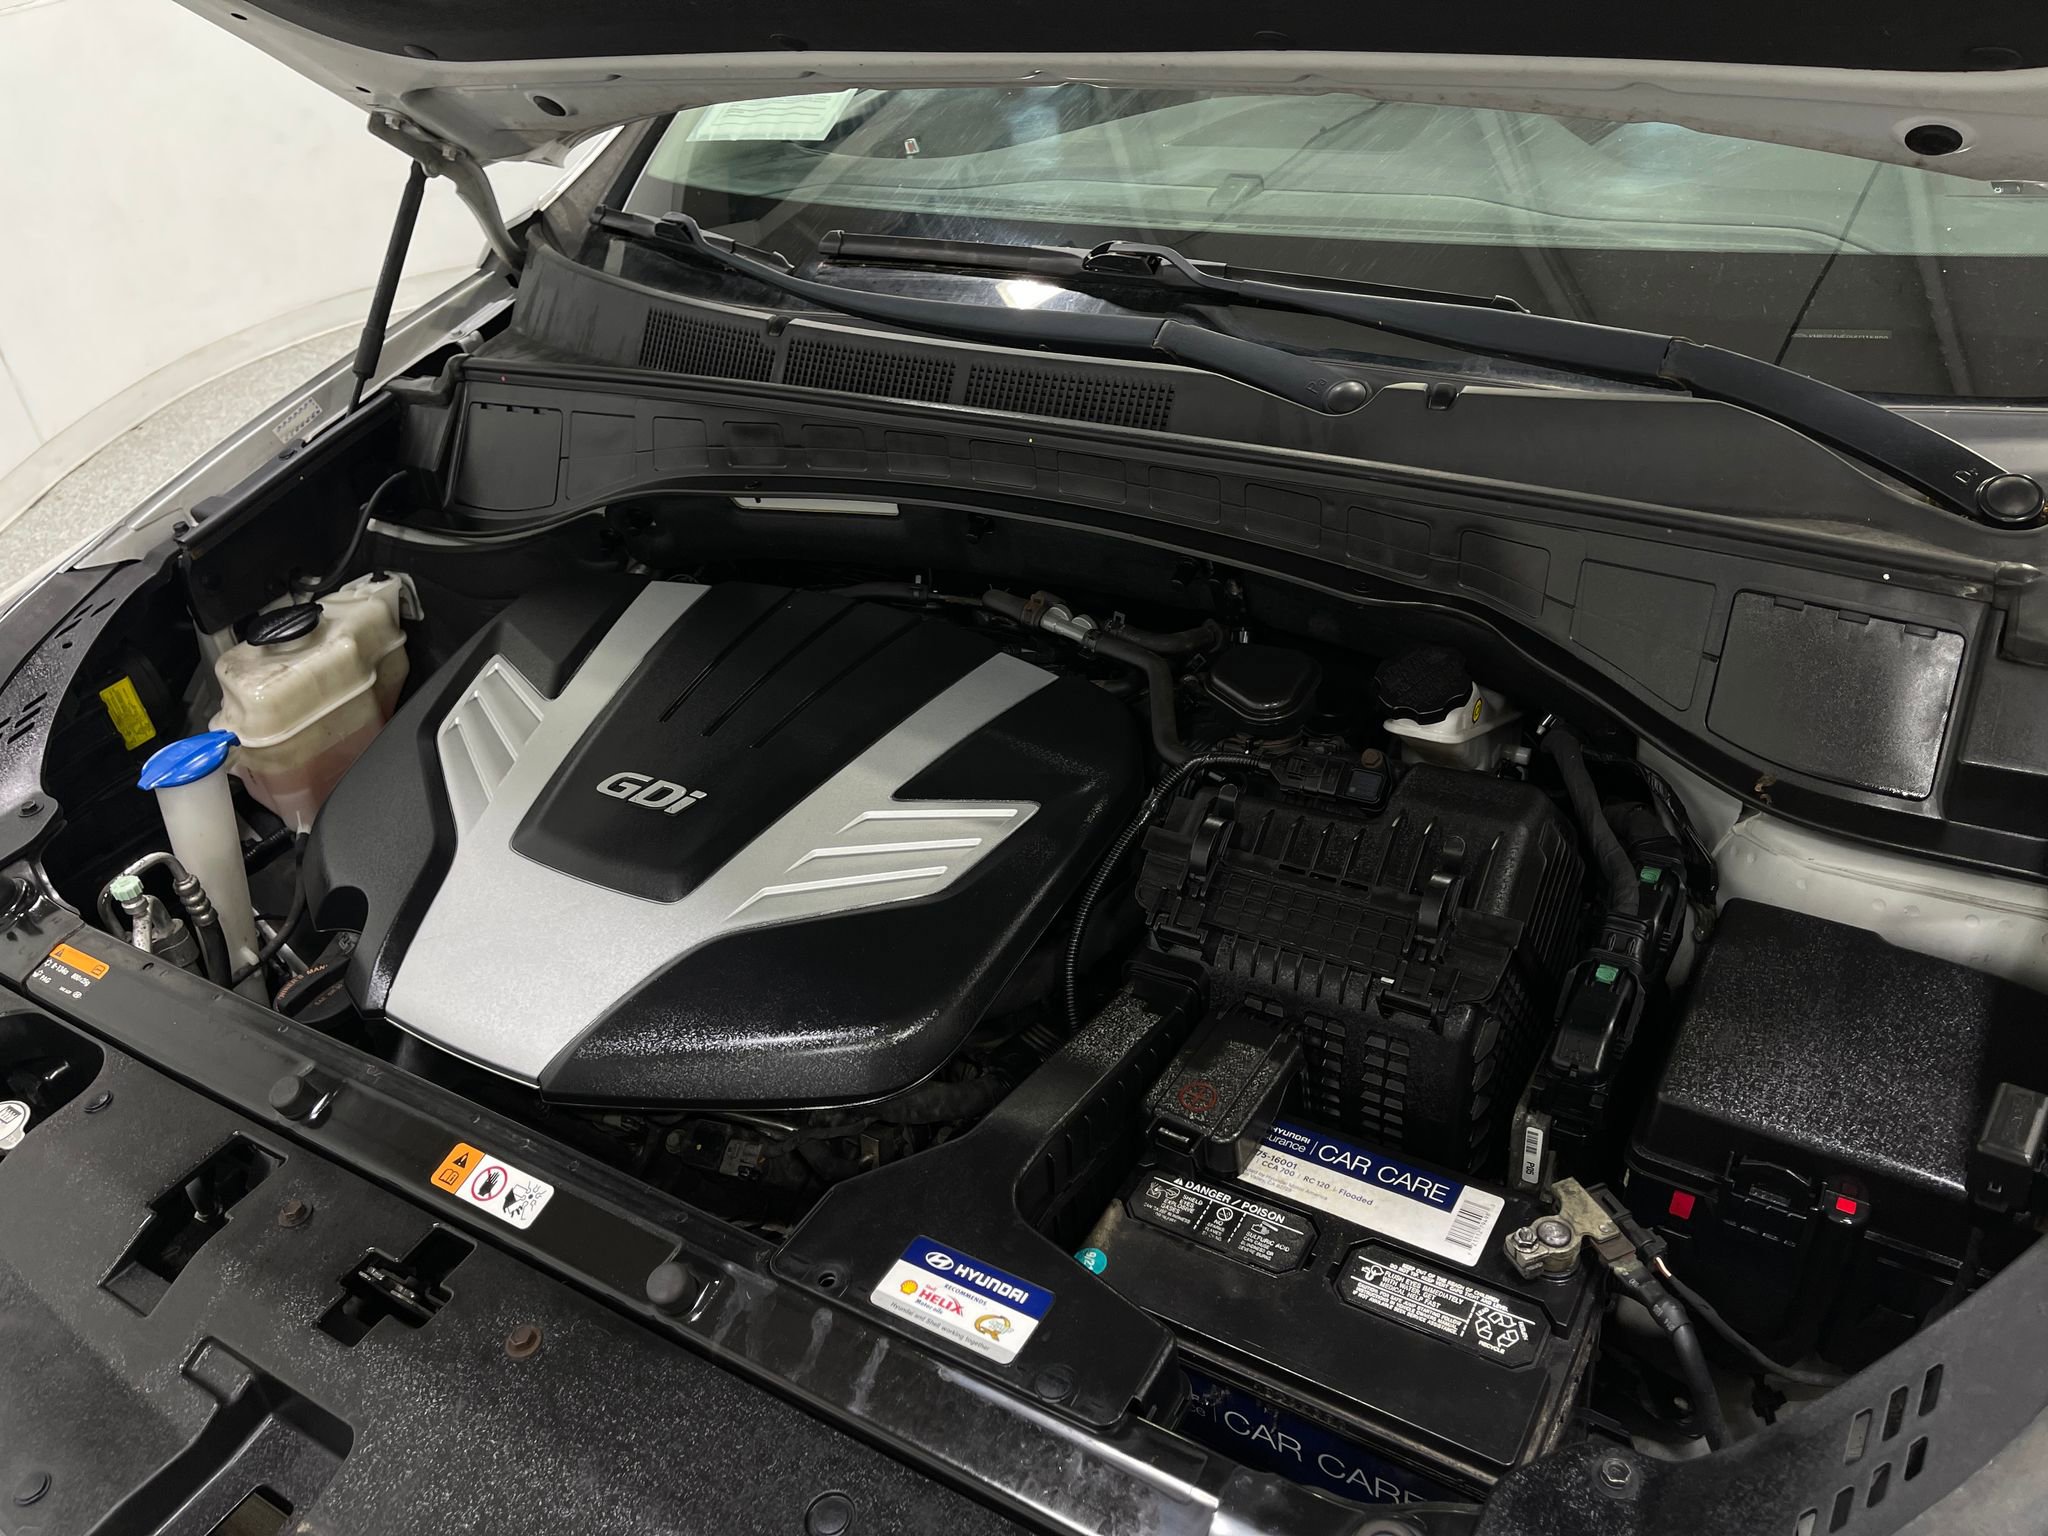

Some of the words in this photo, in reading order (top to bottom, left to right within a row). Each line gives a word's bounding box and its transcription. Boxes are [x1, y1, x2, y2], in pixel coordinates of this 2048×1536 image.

[596, 771, 707, 815] GDi
[1261, 1160, 1278, 1171] CCA
[1279, 1167, 1295, 1177] 700
[1302, 1175, 1316, 1184] RC
[1316, 1180, 1330, 1189] 120
[1338, 1188, 1373, 1205] Flooded
[1318, 1145, 1371, 1174] CAR
[1377, 1166, 1449, 1202] CARE
[1179, 1199, 1194, 1209] EYES
[1185, 1181, 1231, 1203] DANGER
[1241, 1201, 1285, 1225] POISON
[1245, 1231, 1275, 1246] SULFURIC
[1274, 1243, 1290, 1252] ACID
[944, 1283, 986, 1305] RECOMMENDS
[954, 1264, 1028, 1303] HYUNDAI
[1379, 1281, 1405, 1295] MEDICAL
[1406, 1292, 1423, 1301] HELP
[1423, 1298, 1441, 1308] FAST
[1382, 1275, 1398, 1286] WITH
[1422, 1291, 1436, 1300] GET
[1384, 1270, 1405, 1282] FLUSH
[1405, 1278, 1421, 1289] EYES
[1422, 1285, 1464, 1304] IMMEDIATELY
[919, 1289, 963, 1315] HELIX
[1492, 1301, 1508, 1312] LEVEL
[890, 1301, 915, 1316] Hyundai
[914, 1313, 926, 1321] and
[925, 1318, 941, 1328] Shell
[941, 1326, 964, 1341] working
[964, 1336, 990, 1351] together
[1478, 1340, 1505, 1355] RECYCLE
[1224, 1410, 1303, 1462] CAR
